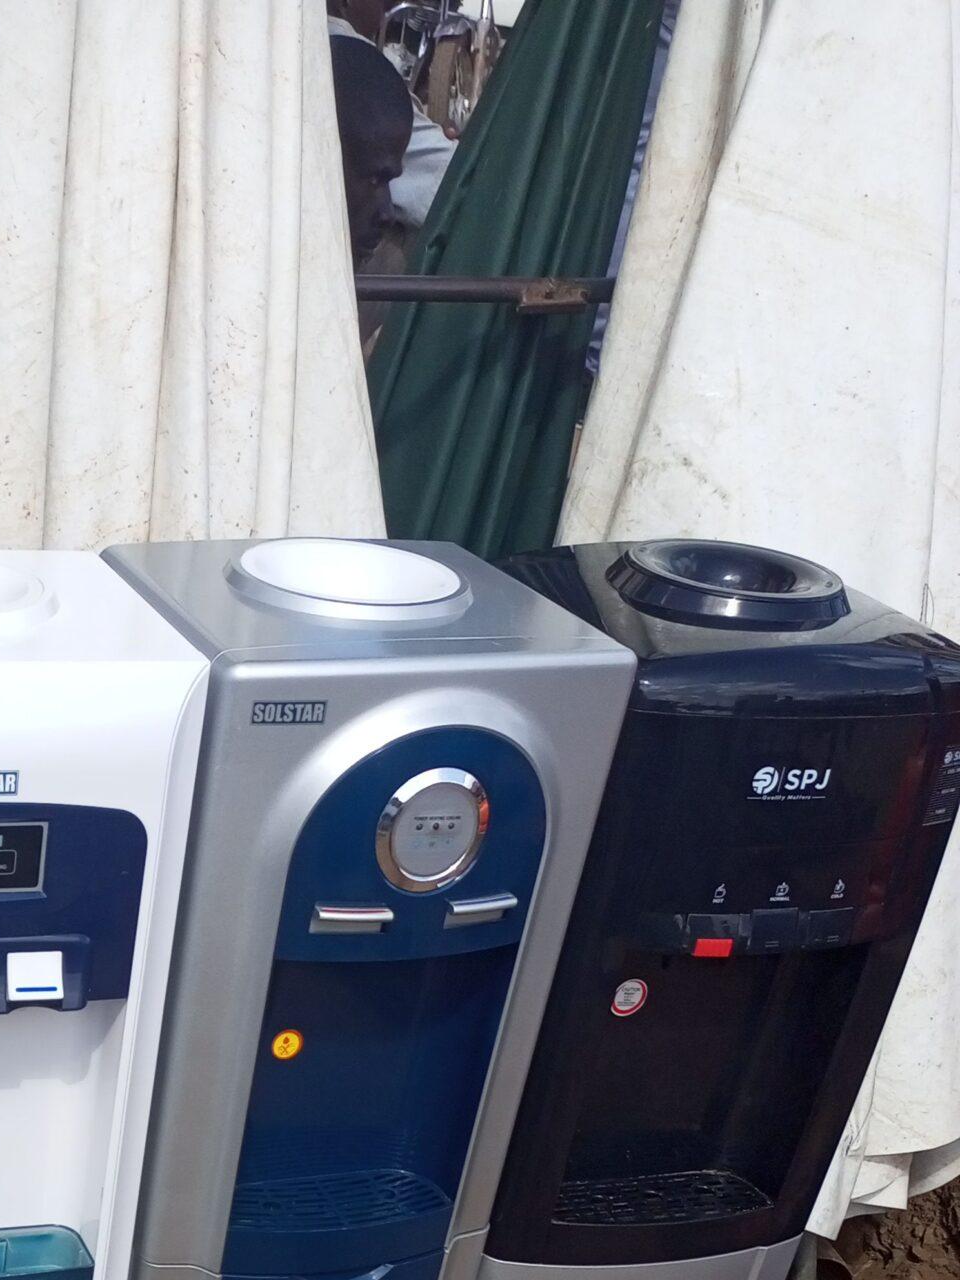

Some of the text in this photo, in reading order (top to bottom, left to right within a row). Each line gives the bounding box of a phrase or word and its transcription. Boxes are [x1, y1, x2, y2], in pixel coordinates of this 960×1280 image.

[252, 702, 326, 723] SOLSTAR
[783, 768, 832, 791] SPJ
[761, 794, 786, 802] Quality
